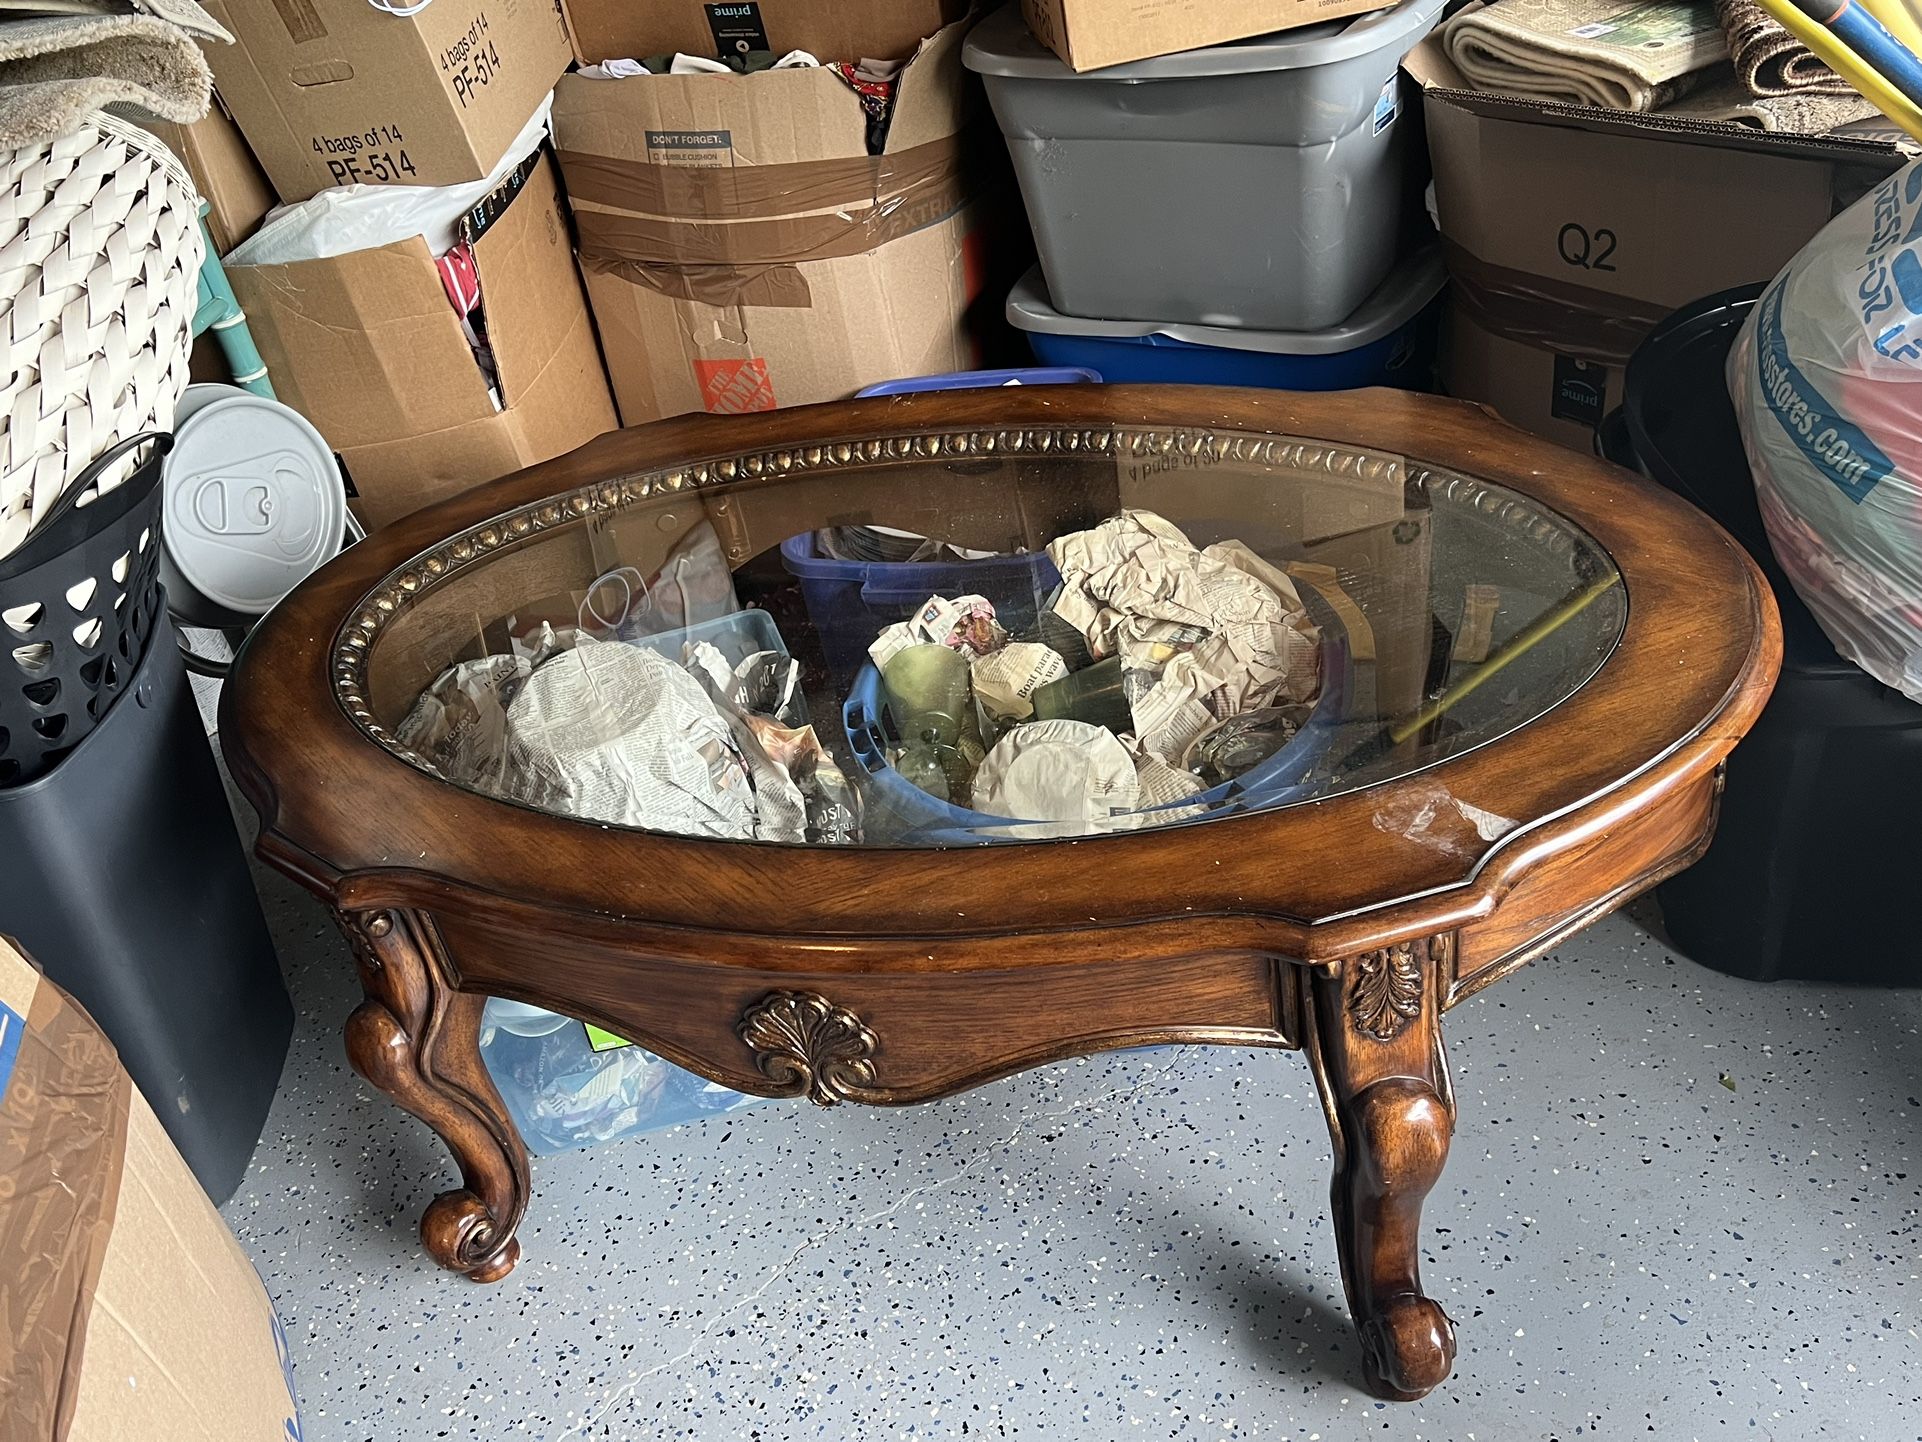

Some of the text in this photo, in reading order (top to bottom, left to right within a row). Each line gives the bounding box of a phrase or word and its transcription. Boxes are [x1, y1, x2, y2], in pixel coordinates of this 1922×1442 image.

[714, 4, 751, 19] prime
[440, 11, 489, 72] 4 bags of 14
[452, 40, 501, 109] PF-514
[312, 124, 403, 155] 4 bags of 14
[652, 135, 679, 144] DON'T
[326, 149, 417, 186] PF-514
[1557, 222, 1618, 272] Q2
[1559, 388, 1598, 408] prime
[1017, 674, 1038, 698] Boat
